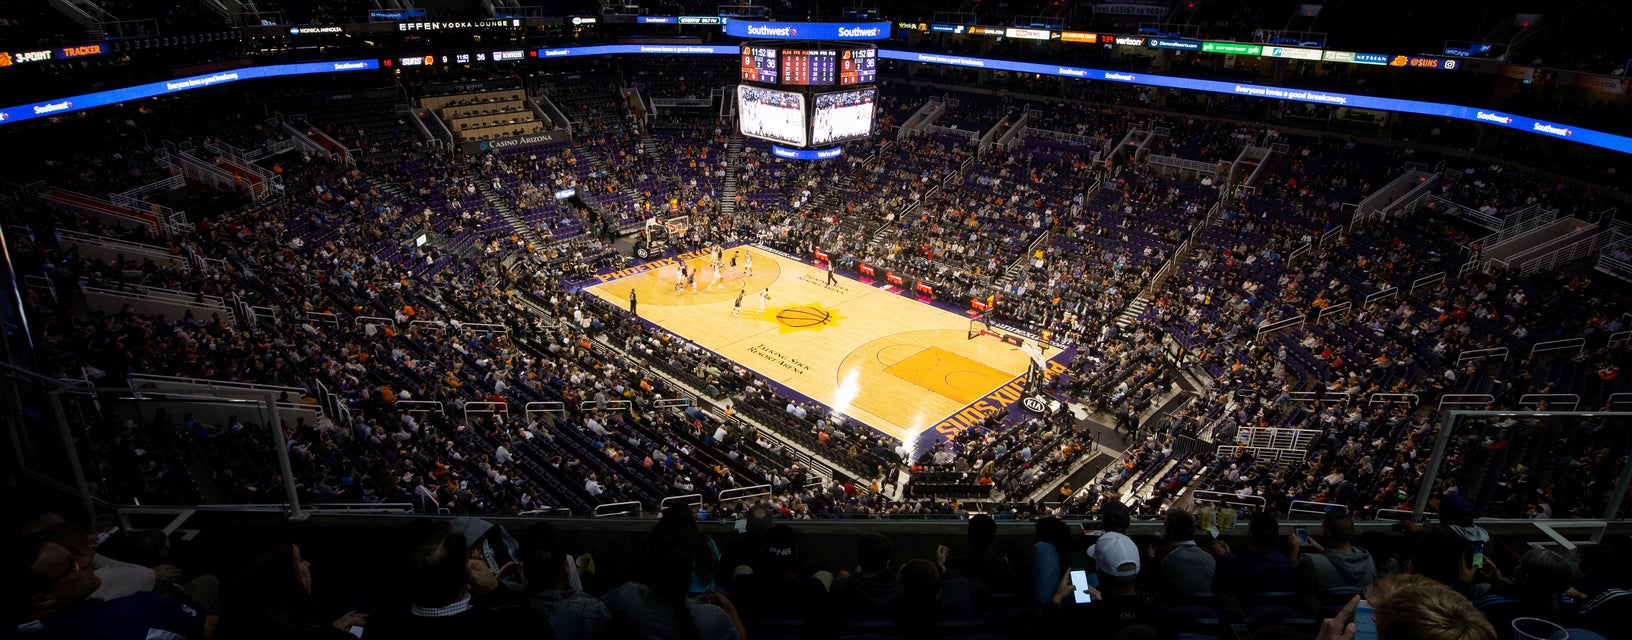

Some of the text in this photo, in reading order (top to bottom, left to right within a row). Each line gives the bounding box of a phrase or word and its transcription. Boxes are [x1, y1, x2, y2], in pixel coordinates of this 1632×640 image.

[400, 22, 440, 31] EFFEN
[748, 25, 790, 36] Southwest
[838, 27, 877, 37] Southwest
[63, 45, 101, 56] TRACKER
[752, 48, 766, 56] 11:52
[852, 50, 866, 58] 11:52
[16, 50, 52, 63] 3-POINT
[745, 57, 750, 65] 9
[767, 60, 775, 68] 36
[845, 61, 850, 69] 9
[866, 59, 874, 68] 36
[1410, 58, 1438, 68] @SUNS
[167, 81, 189, 90] Everyone
[1235, 86, 1265, 95] Everyone
[1266, 89, 1283, 97] loves
[1307, 92, 1346, 104] breakaway.
[34, 101, 69, 114] Southwest
[1477, 112, 1508, 124] Southwest
[1533, 123, 1567, 136] Southwest
[489, 135, 552, 149] CASINO ARIZONA
[600, 256, 674, 282] PHOENIX
[747, 347, 803, 374] RESORT ARENA
[757, 344, 809, 370] TALKING STICK
[1027, 399, 1041, 411] KIA
